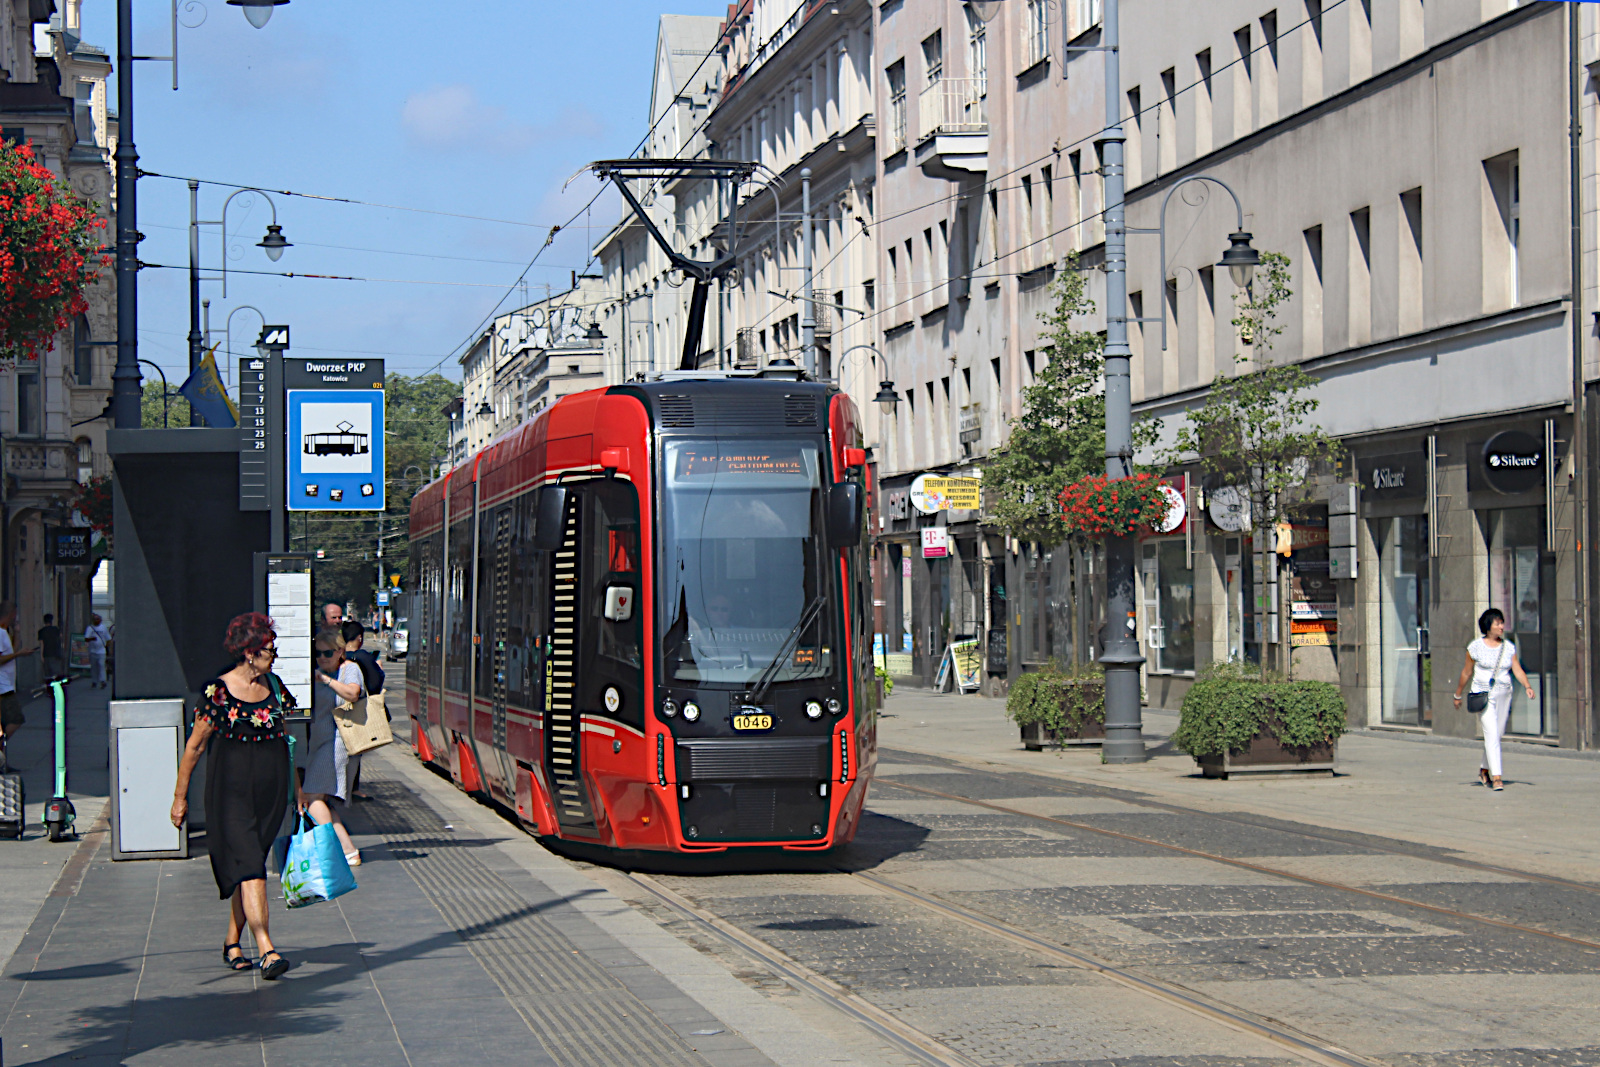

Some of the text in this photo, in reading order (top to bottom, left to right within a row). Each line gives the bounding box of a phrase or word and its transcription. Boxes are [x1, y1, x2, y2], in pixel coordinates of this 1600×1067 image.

[306, 362, 366, 373] Dworzec PKP
[258, 373, 264, 381] 0
[258, 384, 264, 392] 6
[255, 407, 264, 415] 13
[255, 418, 265, 426] 15
[255, 430, 265, 438] 23
[255, 441, 265, 449] 25
[1501, 454, 1537, 466] Silcare
[1380, 468, 1404, 489] Silcare
[924, 479, 946, 487] TELEFONY
[58, 549, 86, 557] SHOP
[736, 717, 769, 729] 1046
